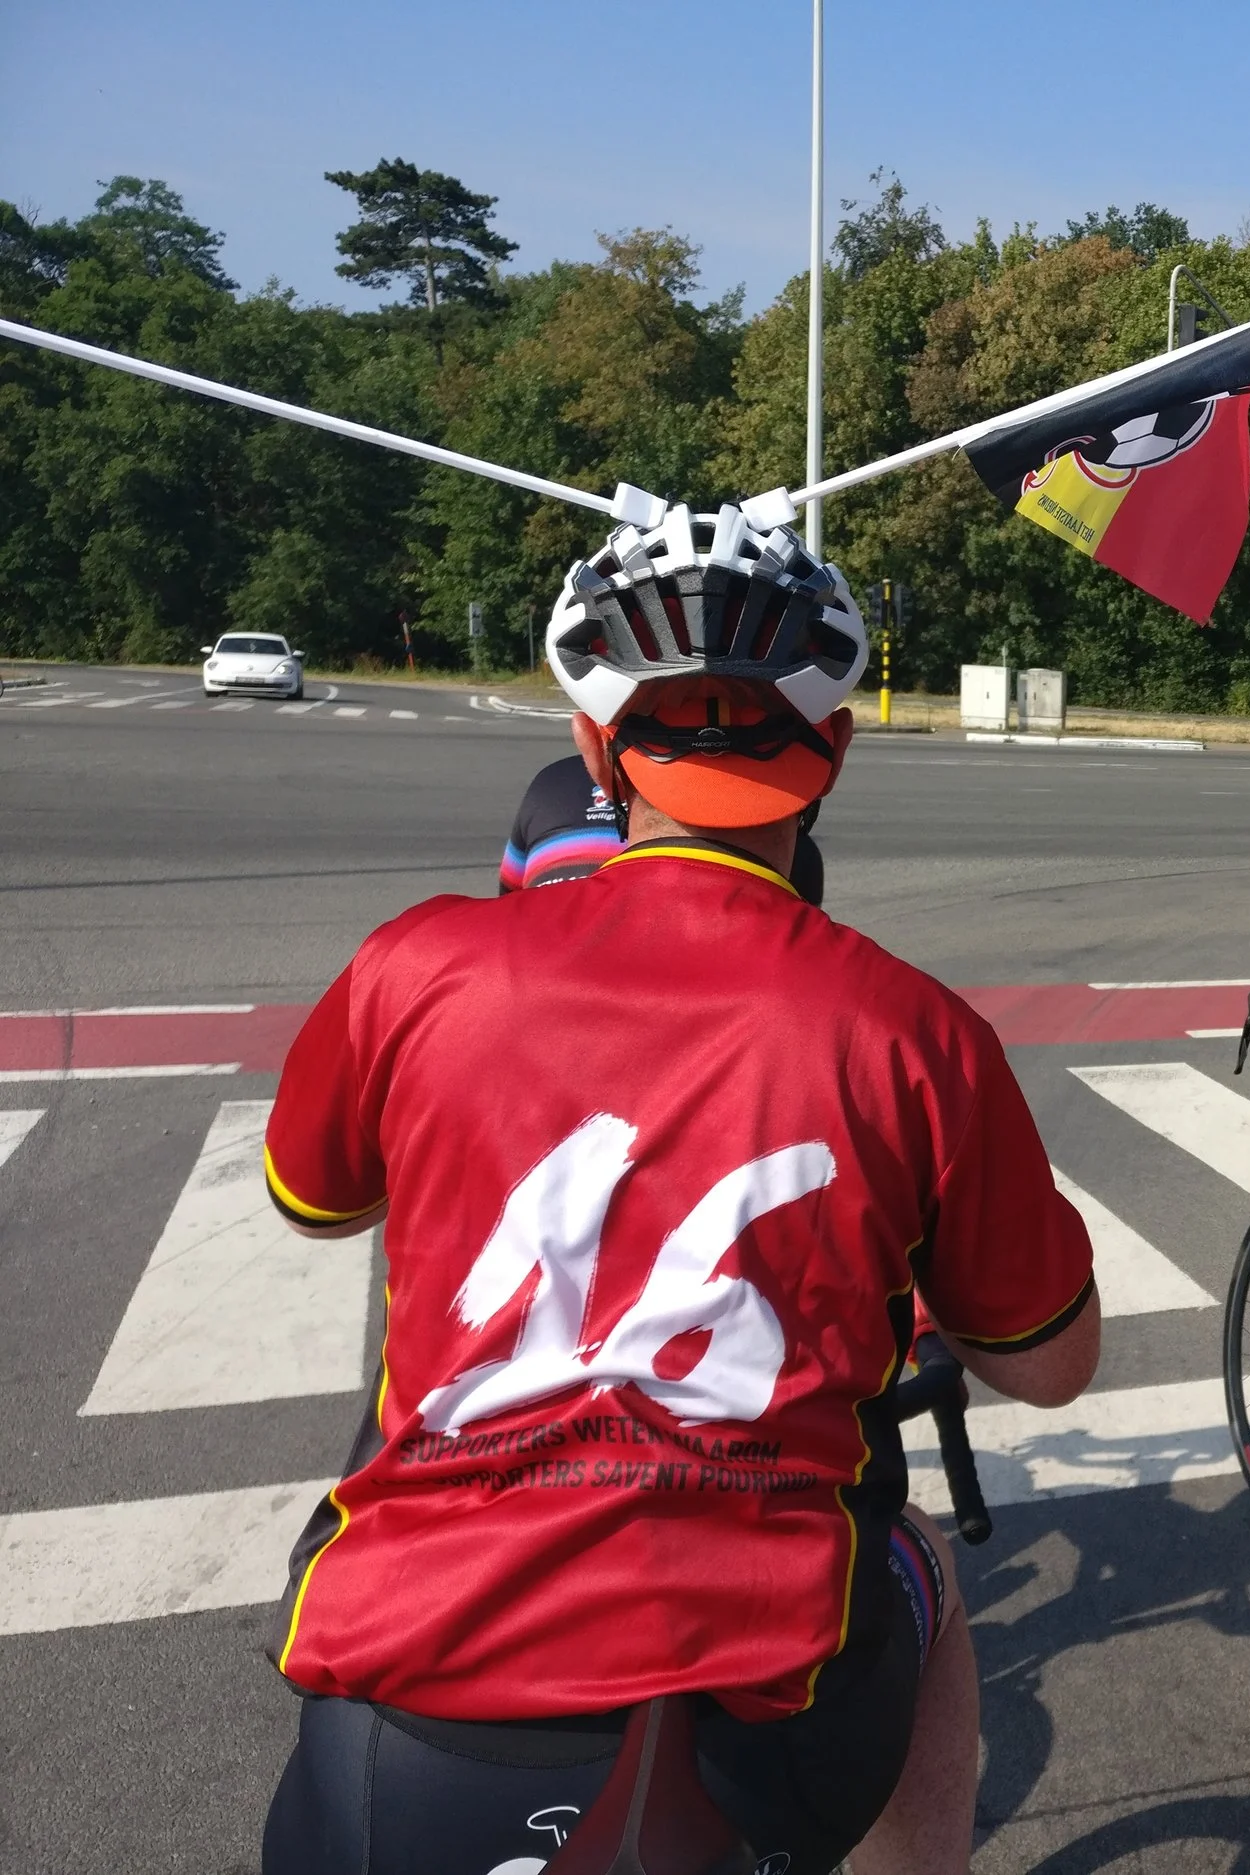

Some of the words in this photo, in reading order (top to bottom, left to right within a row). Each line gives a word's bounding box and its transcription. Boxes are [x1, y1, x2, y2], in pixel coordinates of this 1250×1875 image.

[417, 1108, 838, 1437] 16
[400, 1421, 568, 1465] SUPPORTERS
[572, 1415, 665, 1445] WETEN
[591, 1460, 693, 1492] SAVENT
